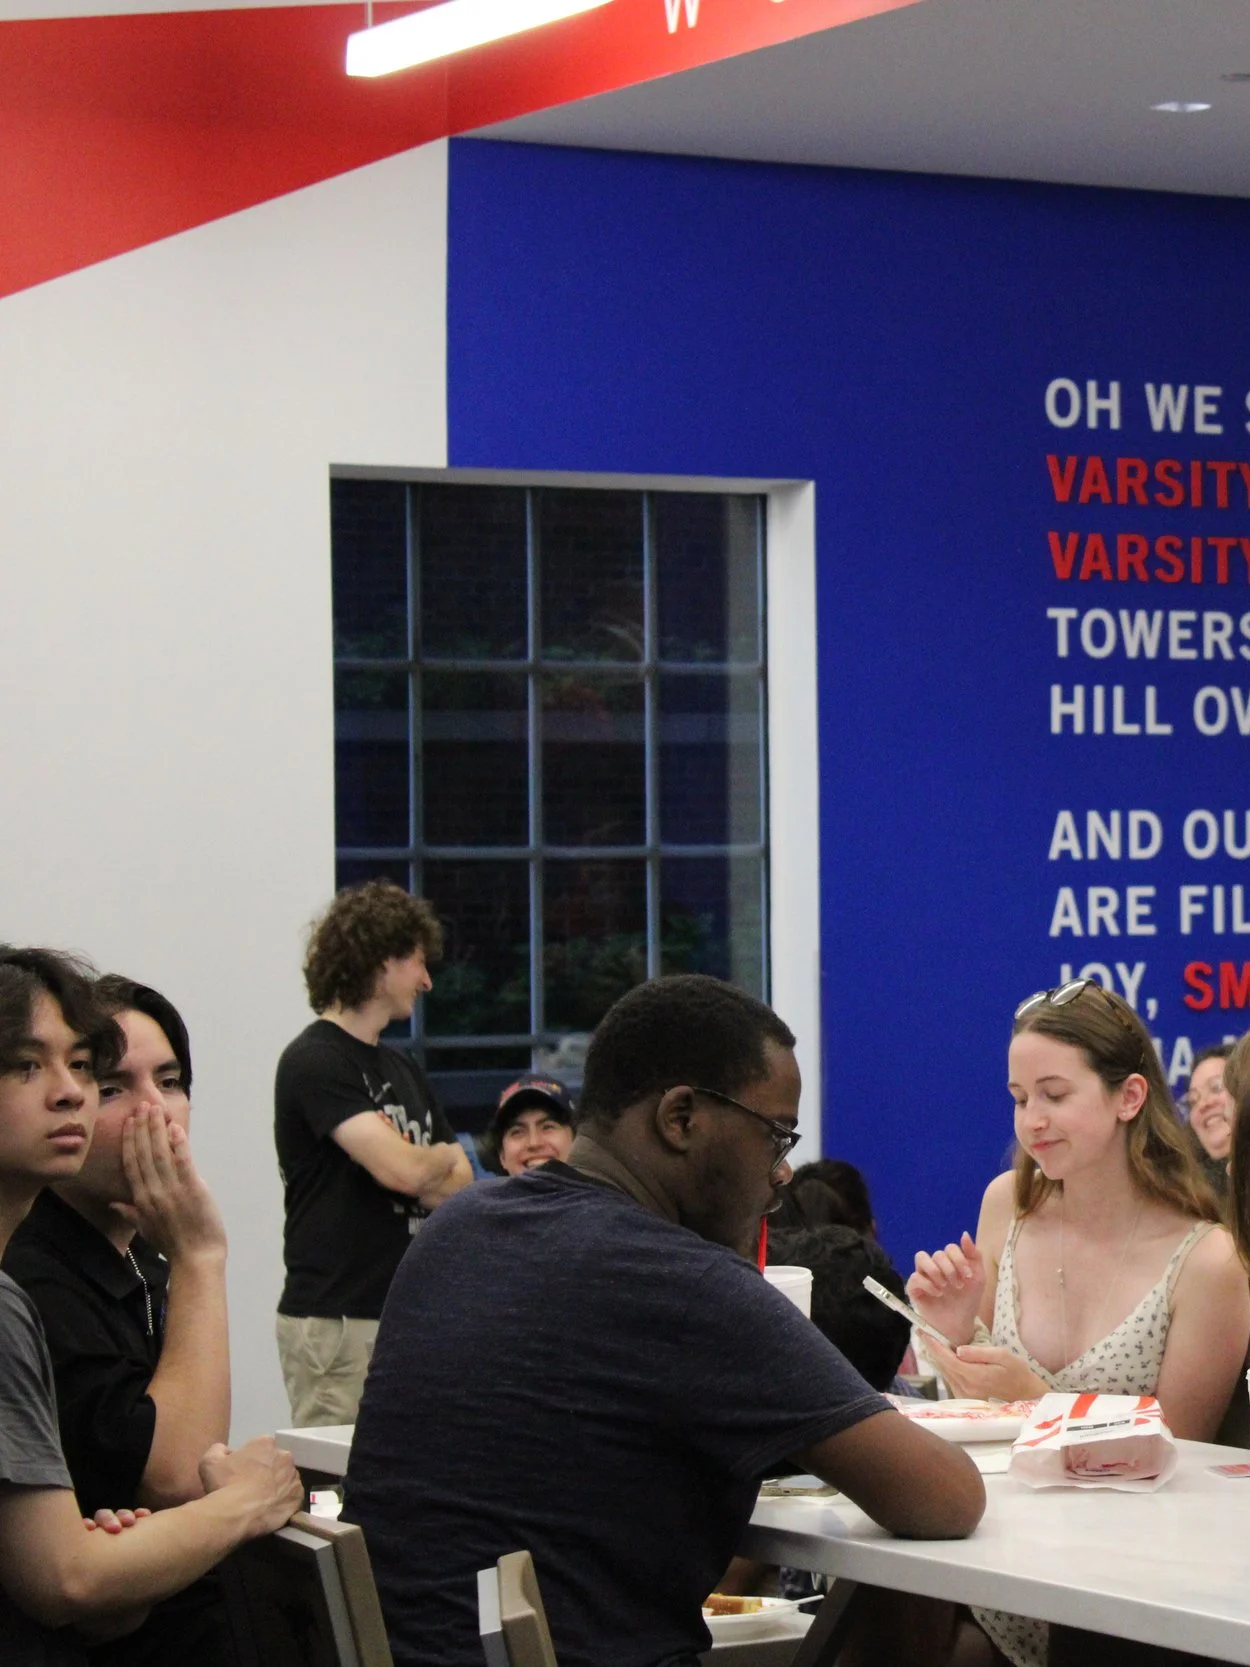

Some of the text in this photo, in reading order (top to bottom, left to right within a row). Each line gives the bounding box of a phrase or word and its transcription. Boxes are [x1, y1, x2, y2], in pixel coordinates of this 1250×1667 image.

[1045, 377, 1121, 430] OH
[1144, 382, 1223, 435] WE
[1050, 683, 1173, 735] HILL
[1048, 809, 1163, 861] AND
[1048, 886, 1158, 938] ARE
